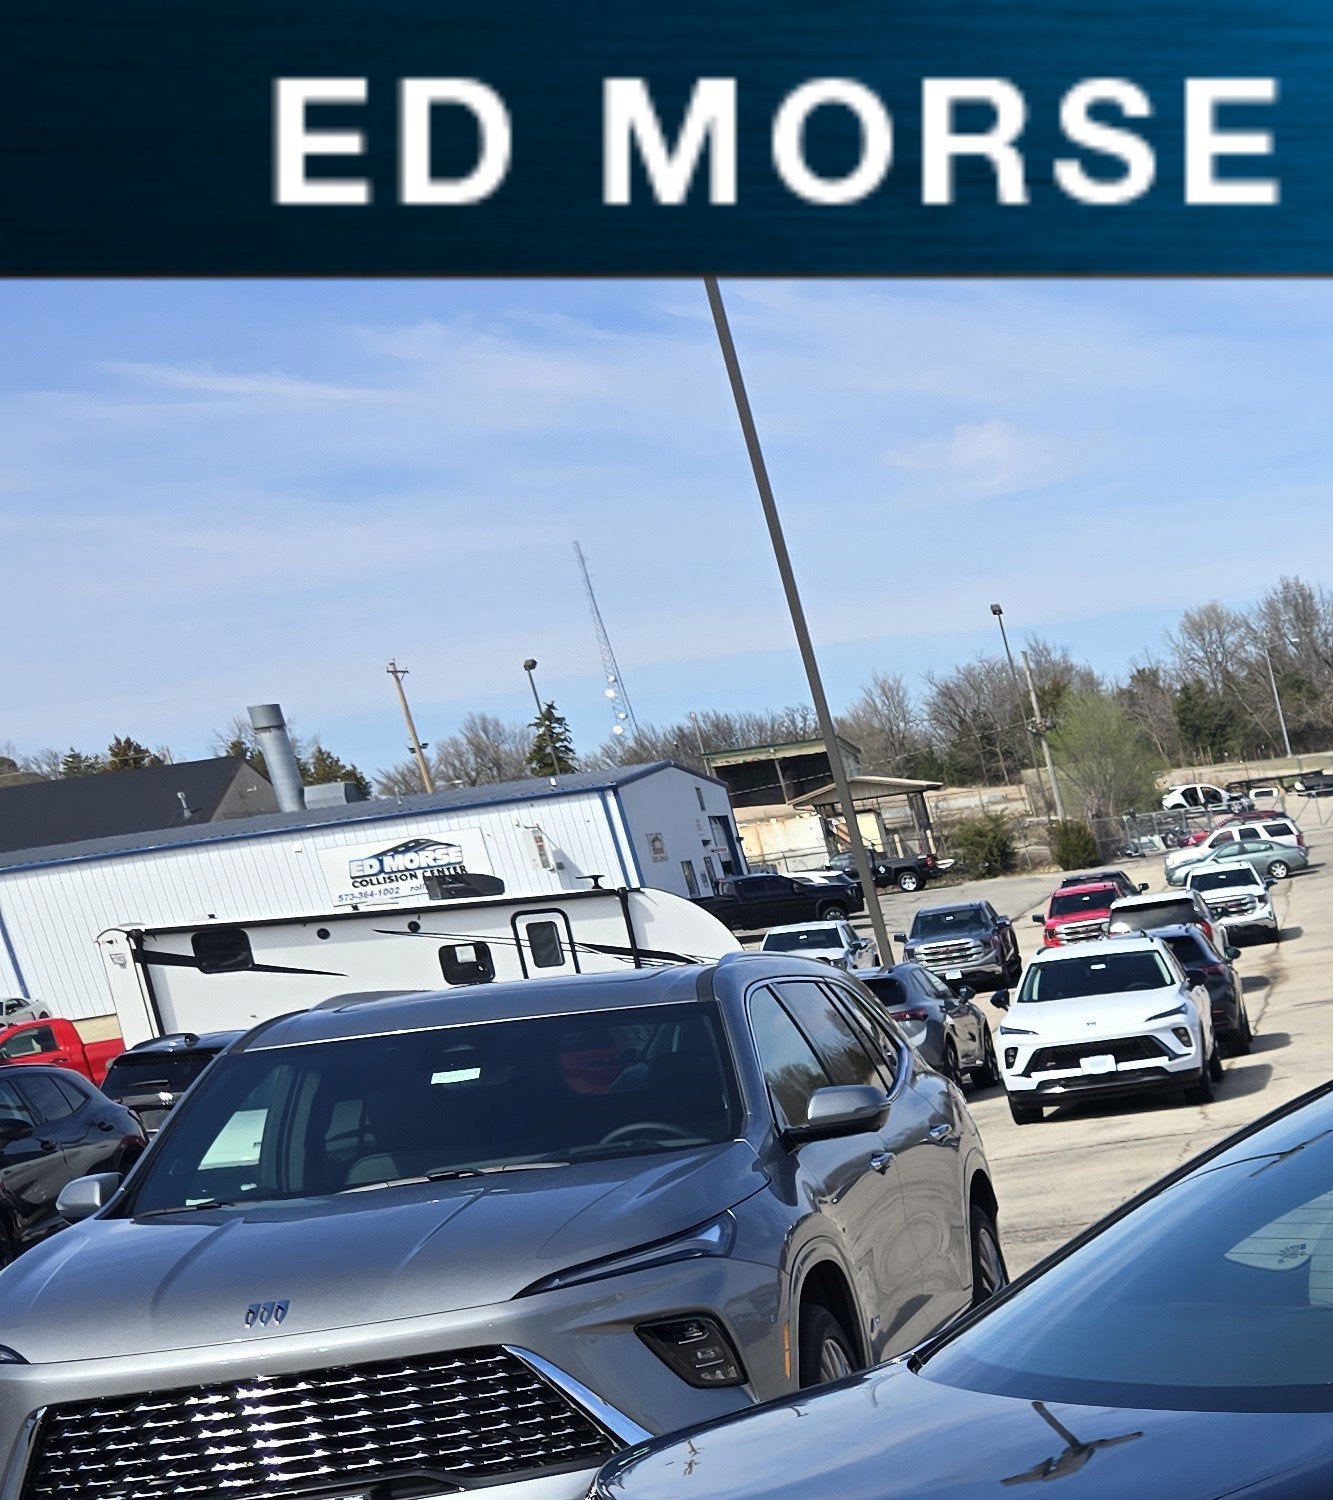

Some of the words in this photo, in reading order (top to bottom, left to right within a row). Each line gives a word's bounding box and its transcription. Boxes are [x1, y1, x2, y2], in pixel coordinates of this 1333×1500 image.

[349, 858, 383, 880] ED
[382, 845, 463, 873] MORSE
[351, 871, 418, 889] COLLISION
[337, 886, 400, 902] 573-364-1002
